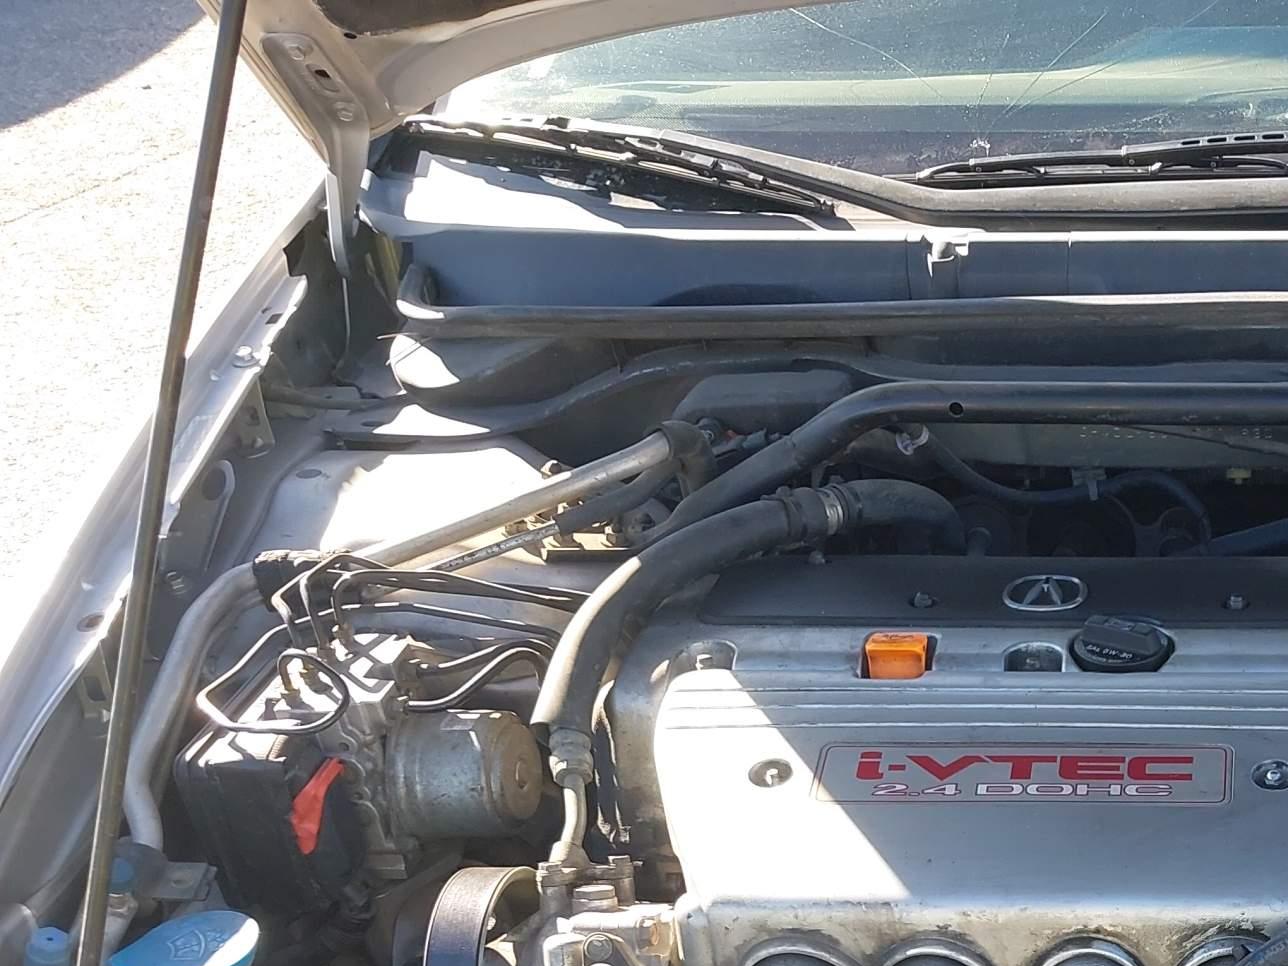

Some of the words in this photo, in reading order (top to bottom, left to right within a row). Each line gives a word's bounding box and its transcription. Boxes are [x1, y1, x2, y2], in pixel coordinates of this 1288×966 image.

[855, 751, 1194, 781] i-VTEC
[871, 783, 961, 797] 2.4
[975, 783, 1172, 797] DOHC
